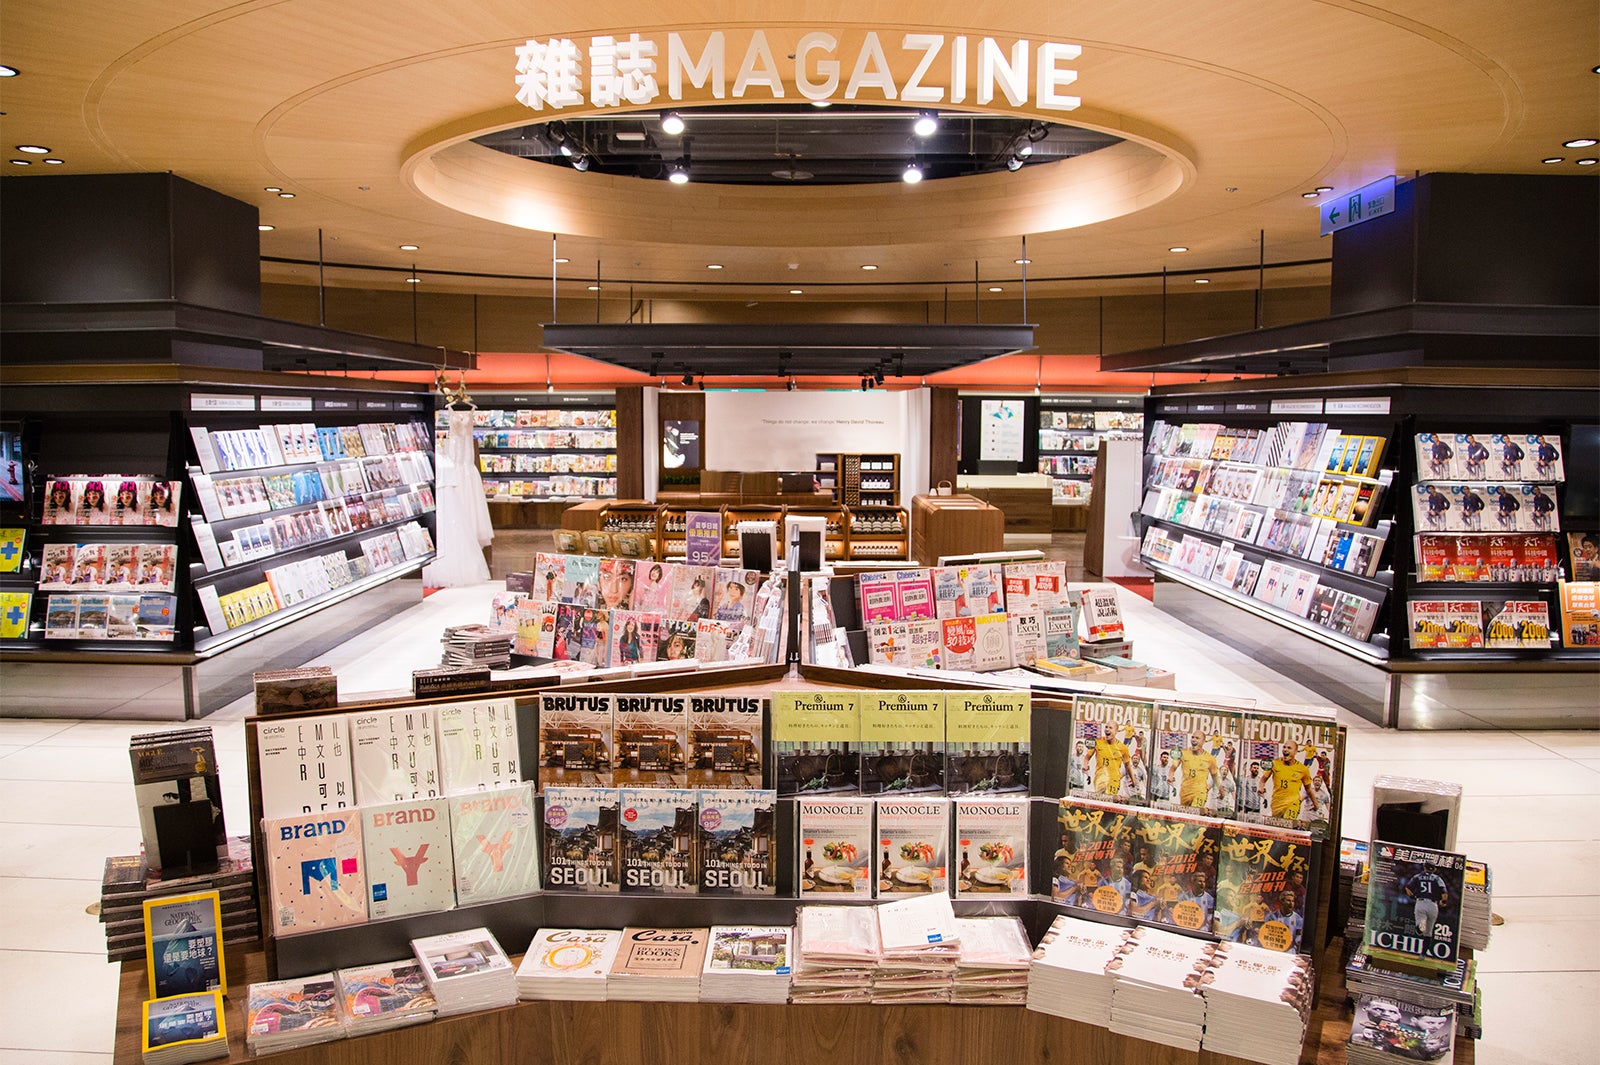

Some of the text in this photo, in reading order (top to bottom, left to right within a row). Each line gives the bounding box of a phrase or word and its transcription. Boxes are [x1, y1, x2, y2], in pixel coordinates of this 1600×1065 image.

[514, 31, 1082, 111] 雜誌 MAGAZINE
[692, 551, 709, 562] 95
[861, 573, 883, 583] Cheers
[896, 571, 917, 580] Cheers
[1017, 622, 1040, 634] Excel
[1048, 620, 1072, 631] Excel
[1420, 620, 1446, 632] 2000
[1453, 620, 1479, 632] 2000
[1490, 621, 1514, 638] 2000
[1521, 620, 1547, 638] 2000
[543, 696, 610, 711] BRUTUS
[617, 697, 684, 712] BRUTUS
[691, 698, 759, 713] BRUTUS
[795, 700, 854, 711] Premium 7
[878, 700, 938, 711] Premium 7
[964, 700, 1024, 712] Premium 7
[357, 716, 377, 725] circle
[1075, 701, 1151, 728] FOOTBALL
[1160, 708, 1240, 738] FOOTBALL
[263, 726, 285, 735] circle
[1249, 719, 1334, 748] FOOTBALL
[1102, 757, 1110, 767] 13
[1188, 768, 1196, 778] 13
[1280, 779, 1289, 789] 13
[803, 806, 864, 815] MONOCLE
[879, 806, 941, 815] MONOCLE
[958, 806, 1020, 816] MONOCLE
[1057, 809, 1136, 841] 世界杯
[1135, 822, 1220, 855] 世界杯
[1088, 840, 1115, 851] 2018
[1168, 853, 1197, 864] 2018
[1221, 837, 1310, 872] 世界杯
[551, 857, 566, 865] 101
[627, 858, 642, 867] 101
[705, 859, 721, 868] 101
[551, 867, 613, 885] SEOUL
[626, 868, 690, 887] SEOUL
[705, 869, 768, 888] SEOUL
[1255, 871, 1287, 883] 2018
[1420, 881, 1432, 893] 51
[546, 931, 607, 943] Casa
[632, 929, 693, 942] Casa
